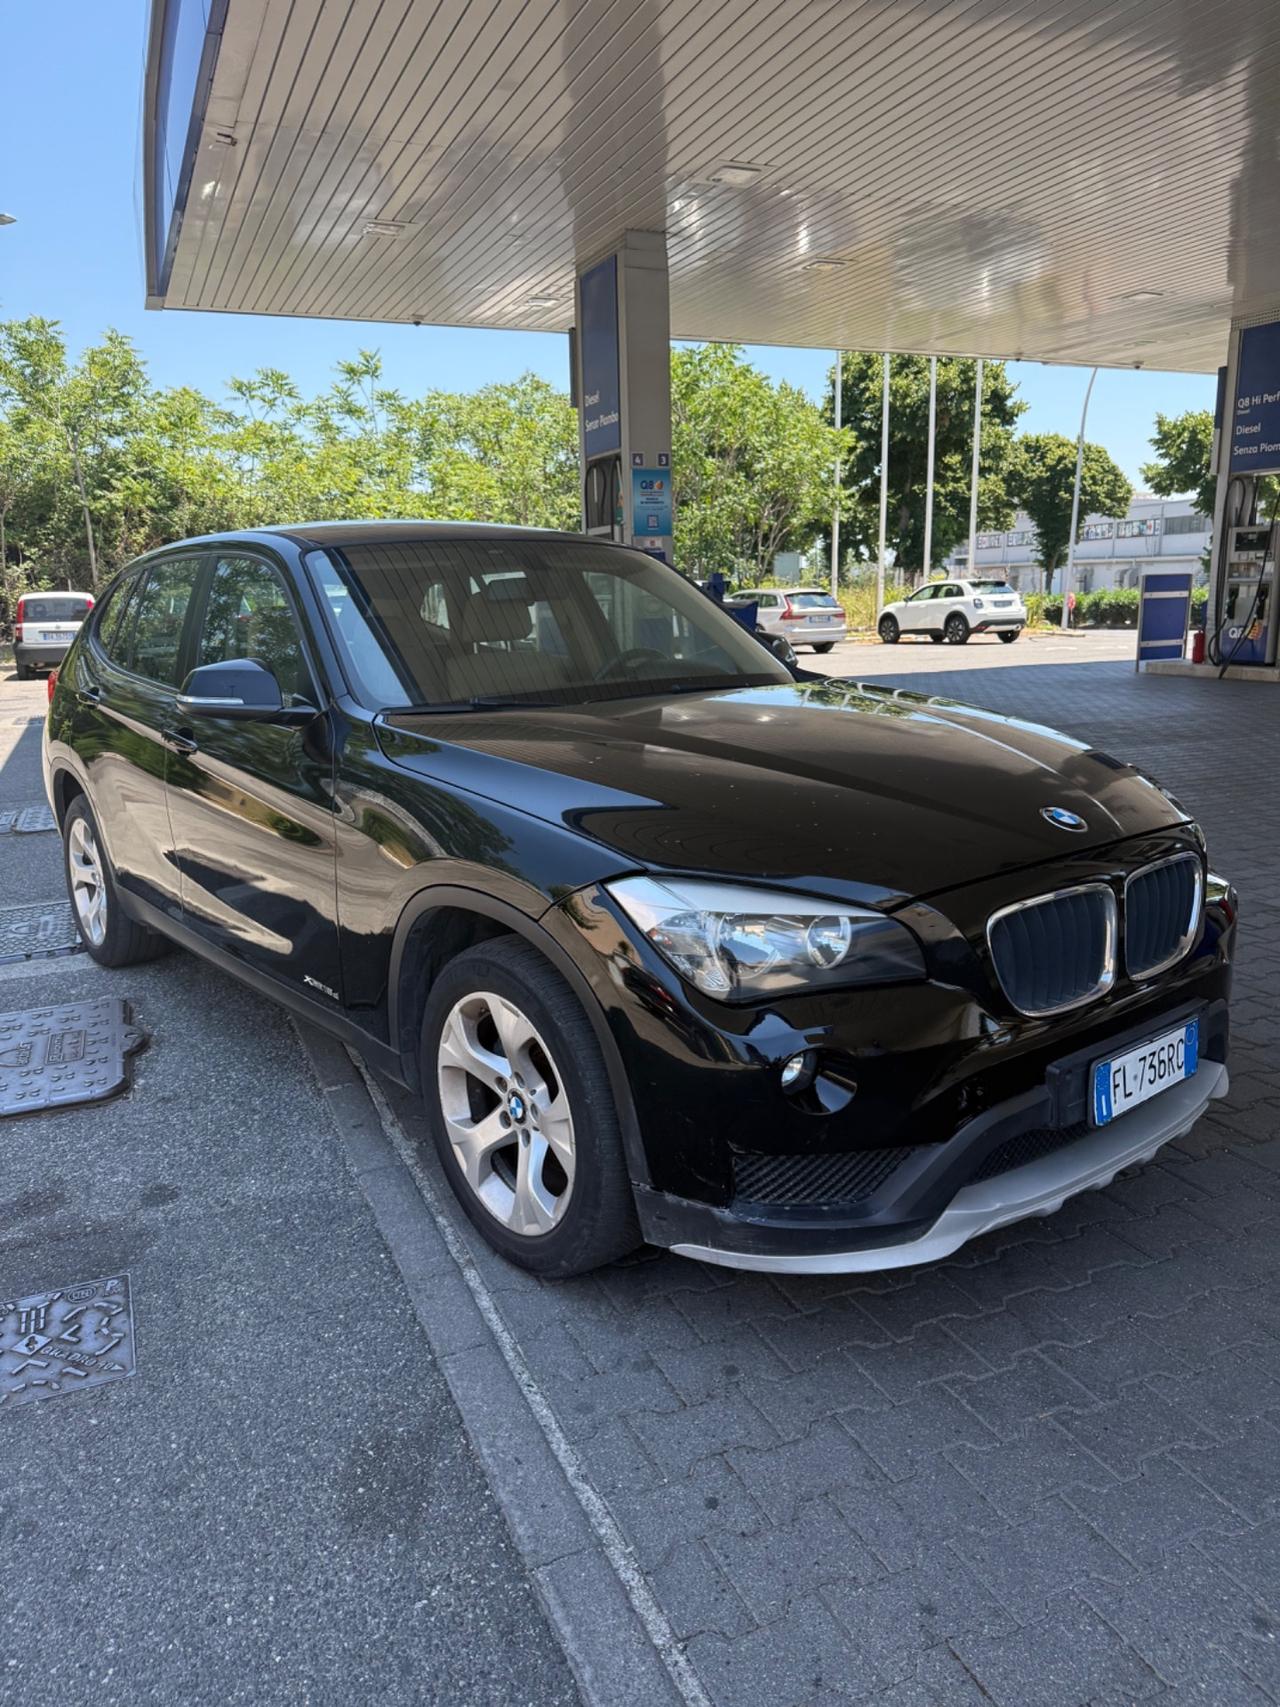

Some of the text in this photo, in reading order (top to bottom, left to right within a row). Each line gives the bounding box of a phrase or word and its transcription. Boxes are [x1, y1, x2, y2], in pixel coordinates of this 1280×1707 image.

[1237, 397, 1250, 409] Q8
[1251, 395, 1262, 406] Hi
[1236, 422, 1261, 435] Diesel
[1233, 445, 1258, 456] Senza
[1138, 1038, 1184, 1093] 736RC
